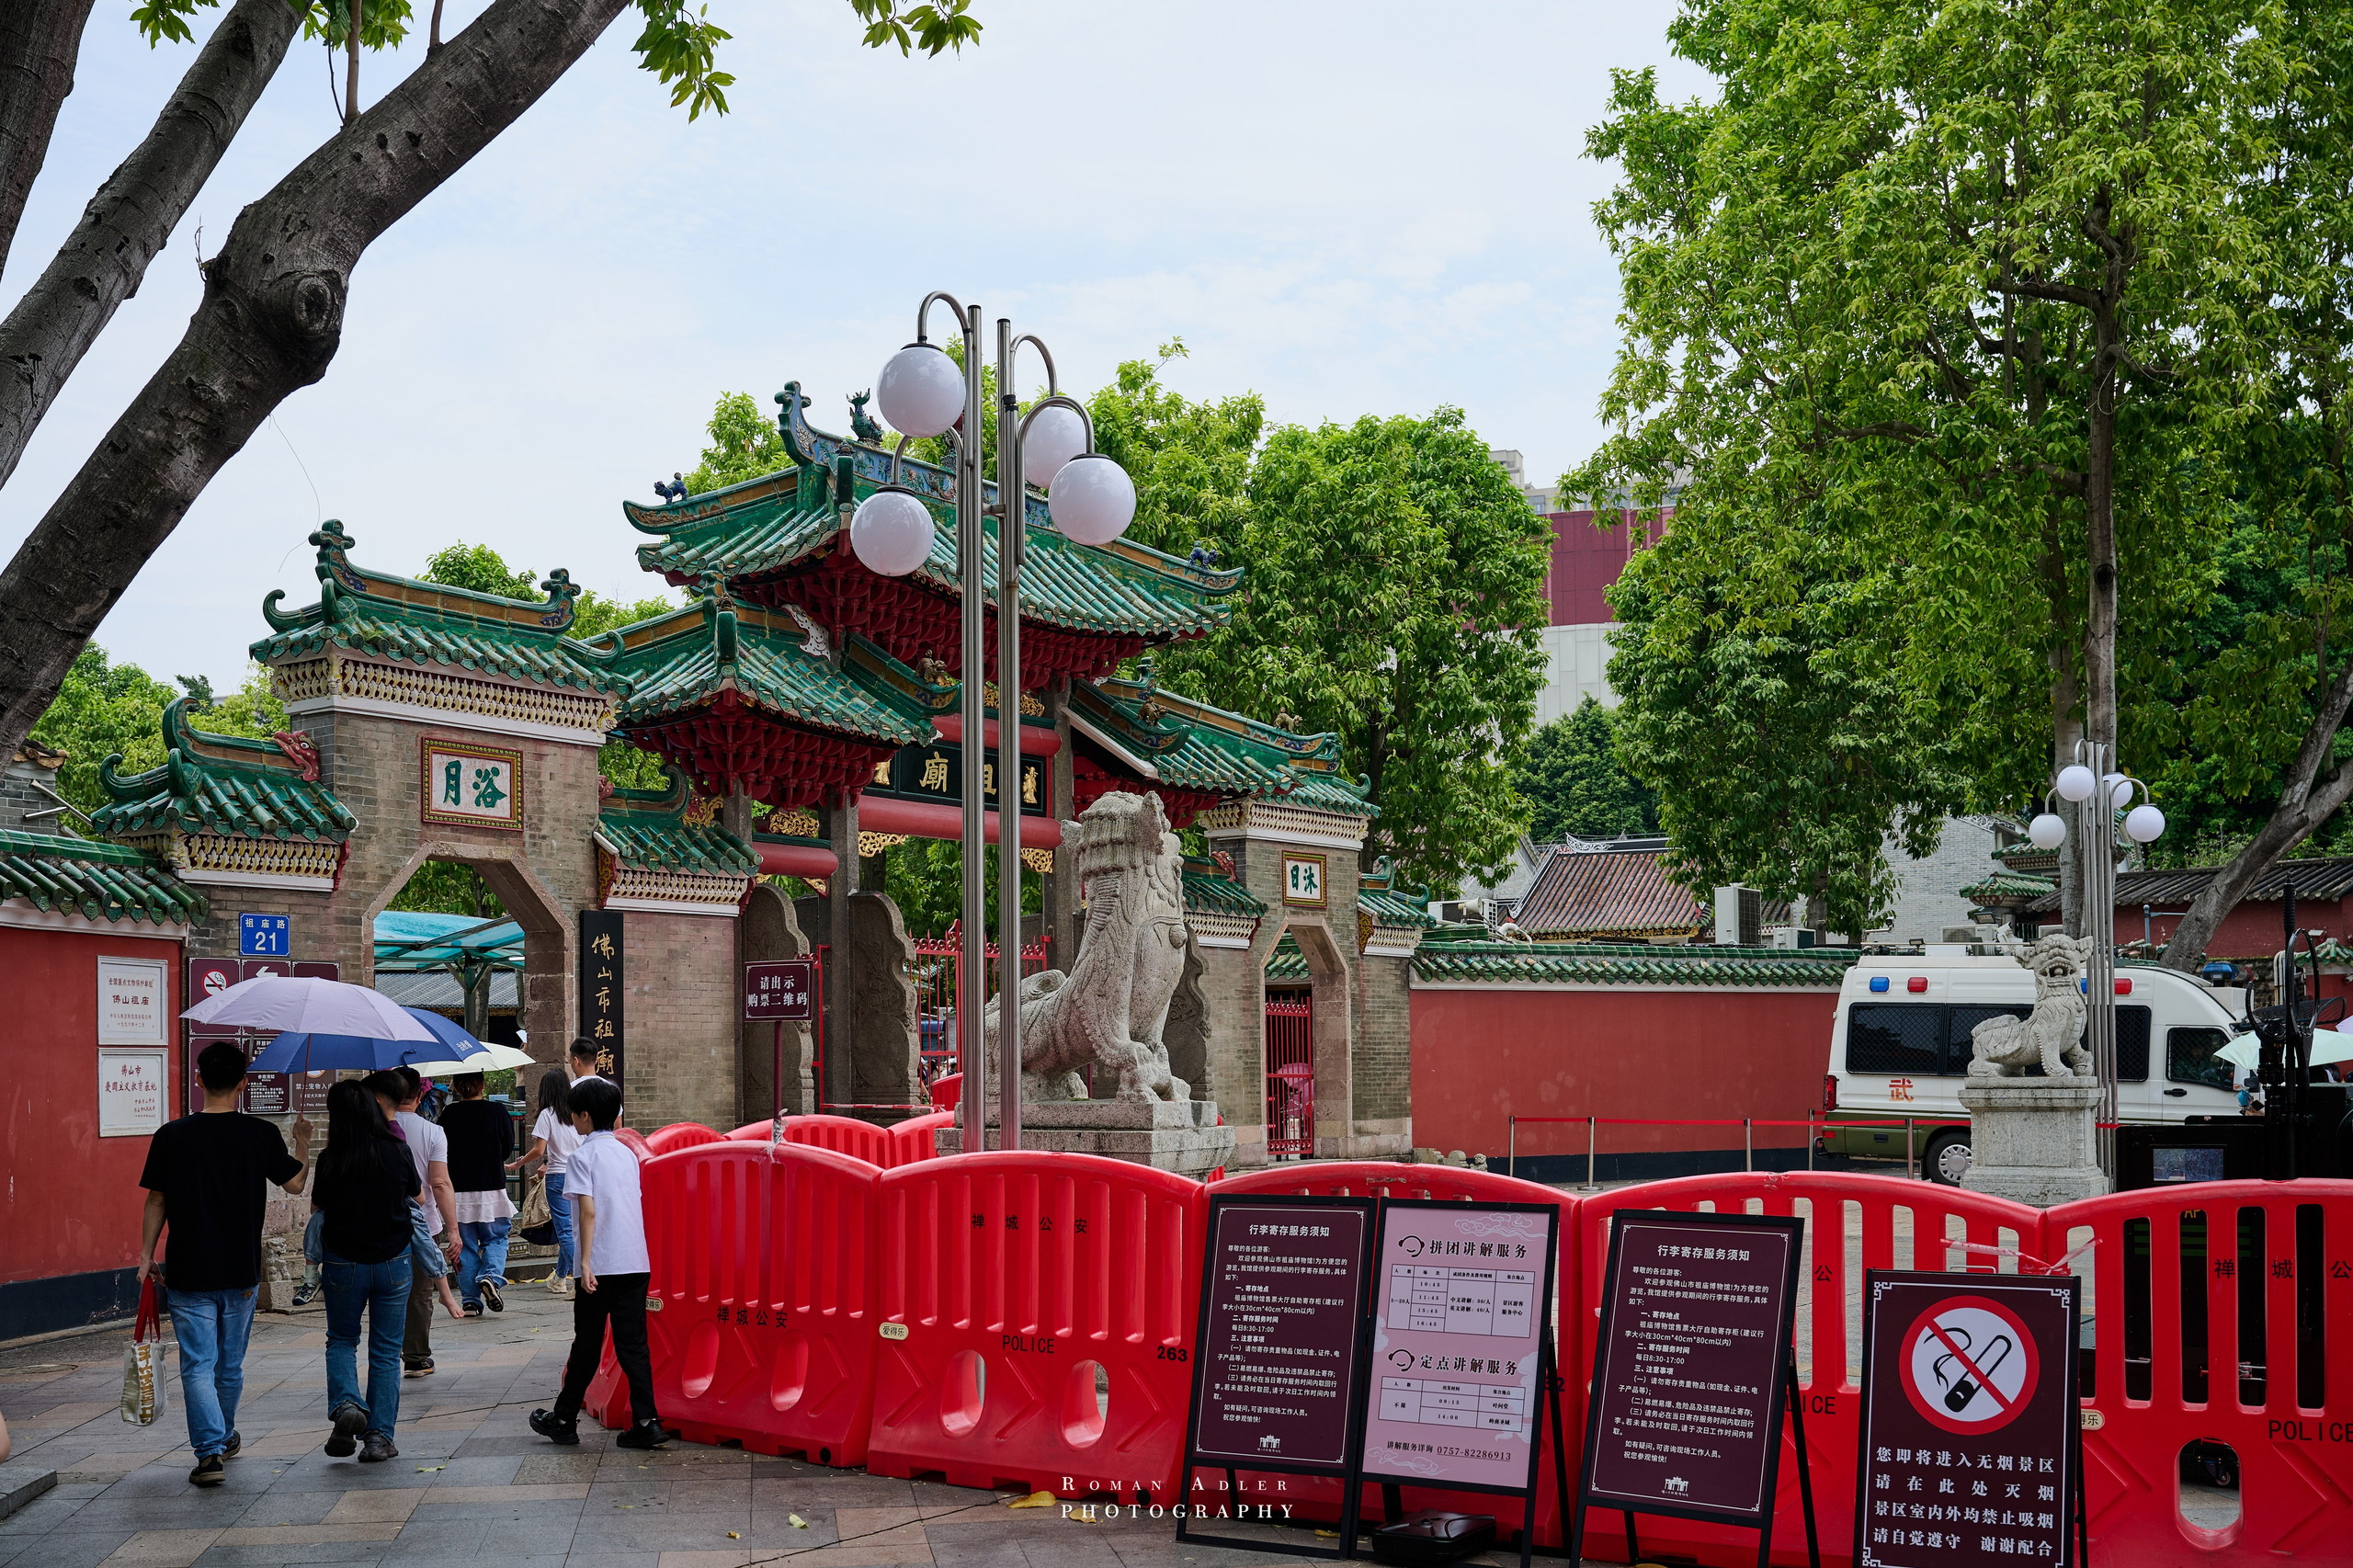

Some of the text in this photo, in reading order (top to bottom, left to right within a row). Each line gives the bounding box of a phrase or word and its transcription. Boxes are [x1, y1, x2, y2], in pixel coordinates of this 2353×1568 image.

[245, 918, 286, 928] 祖庙路
[255, 931, 276, 951] 21
[760, 975, 794, 990] 请出示
[112, 994, 149, 1005] 佛山祖庙
[748, 993, 807, 1006] 购票二维码
[121, 1064, 142, 1077] 佛山市
[105, 1081, 157, 1093] 爱国主义教育基地
[1889, 1078, 1914, 1103] 武
[972, 1213, 1087, 1233] 禅城公安
[1249, 1224, 1330, 1236] 行李寄存服务须知
[1429, 1240, 1527, 1258] 拼团讲解服务
[1657, 1244, 1750, 1261] 行李寄存服务须知
[717, 1305, 788, 1328] 禅城公安
[883, 1326, 904, 1336] 爱得乐
[1003, 1335, 1054, 1353] POLICE
[1157, 1346, 1188, 1361] 263
[1420, 1355, 1518, 1375] 定点讲解服务
[2268, 1420, 2353, 1442] POLICE
[1387, 1441, 1511, 1460] 讲解服务详询 0757-82286913
[1876, 1447, 2054, 1473] 您即将进入无烟景区
[1875, 1474, 2054, 1501] 请在此处灭烟
[1874, 1501, 2053, 1528] 景区室内外均禁止吸烟
[1873, 1528, 2052, 1556] 请自觉遵守 谢谢配合
